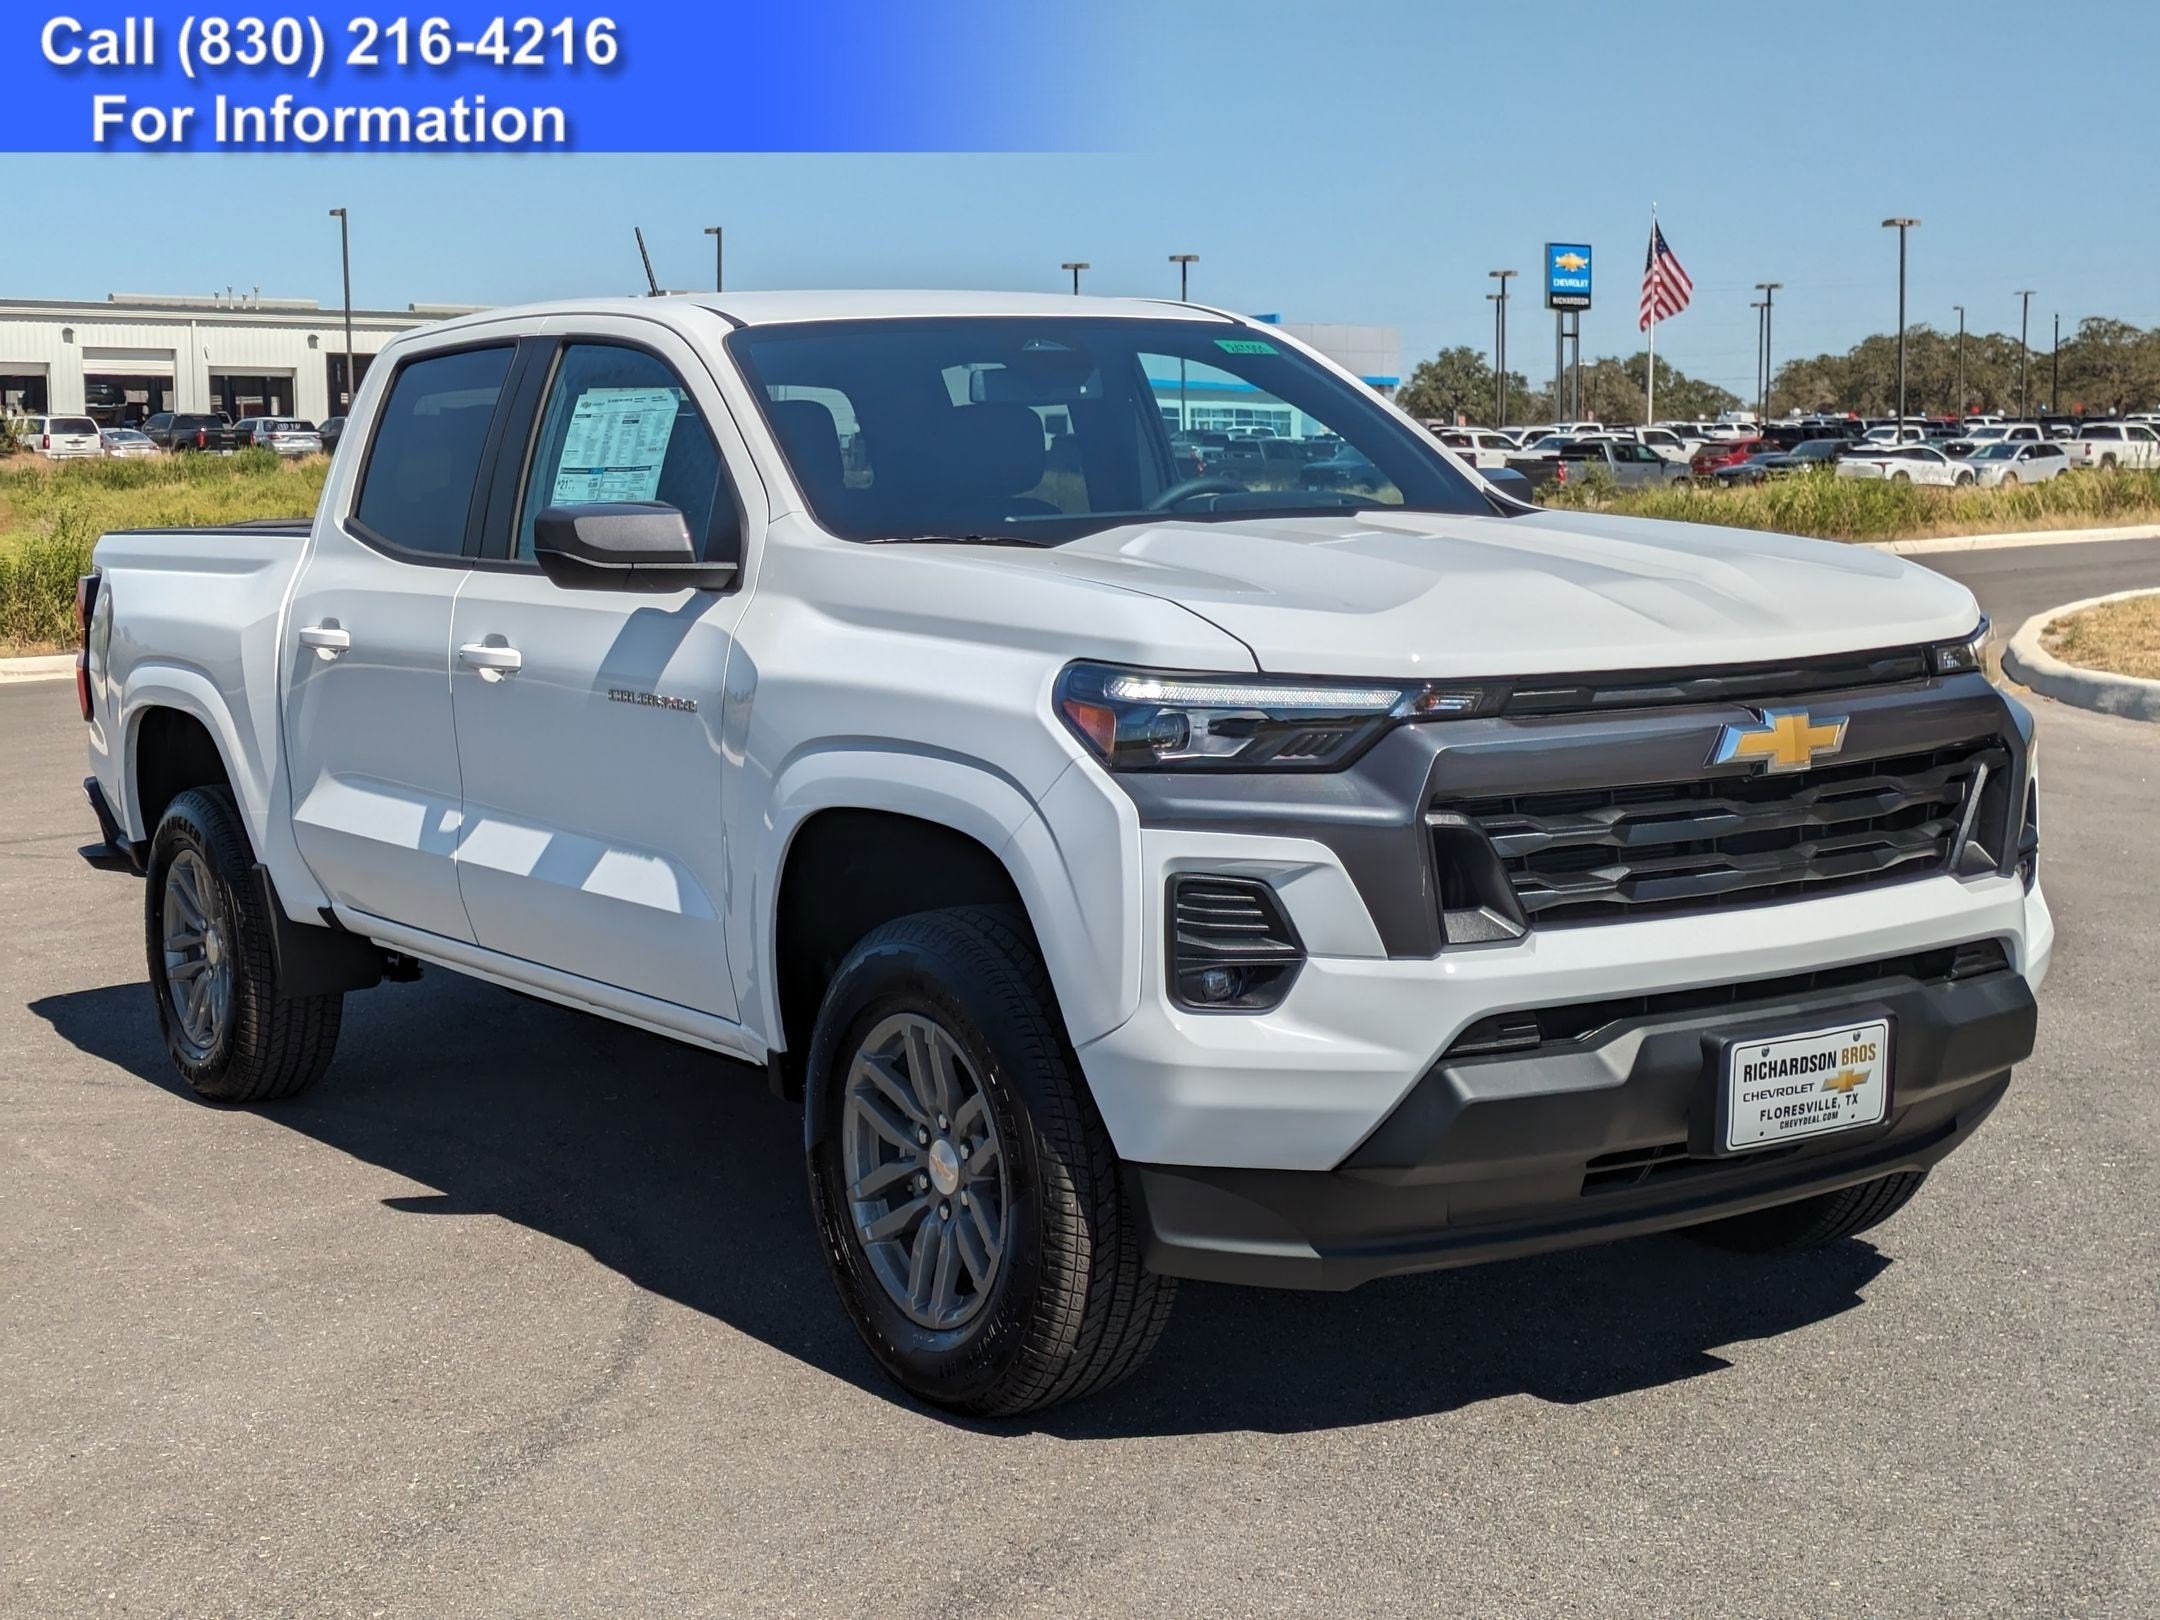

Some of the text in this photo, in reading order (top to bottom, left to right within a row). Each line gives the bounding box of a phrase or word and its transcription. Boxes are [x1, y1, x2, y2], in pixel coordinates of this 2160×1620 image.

[1743, 1043, 1876, 1083] RICHARDSON BROS
[1743, 1082, 1815, 1103] CHEVROLET
[1759, 1092, 1859, 1122] FLORESVILLE, TX
[1779, 1111, 1839, 1130] CHEVYDEAL.COM
